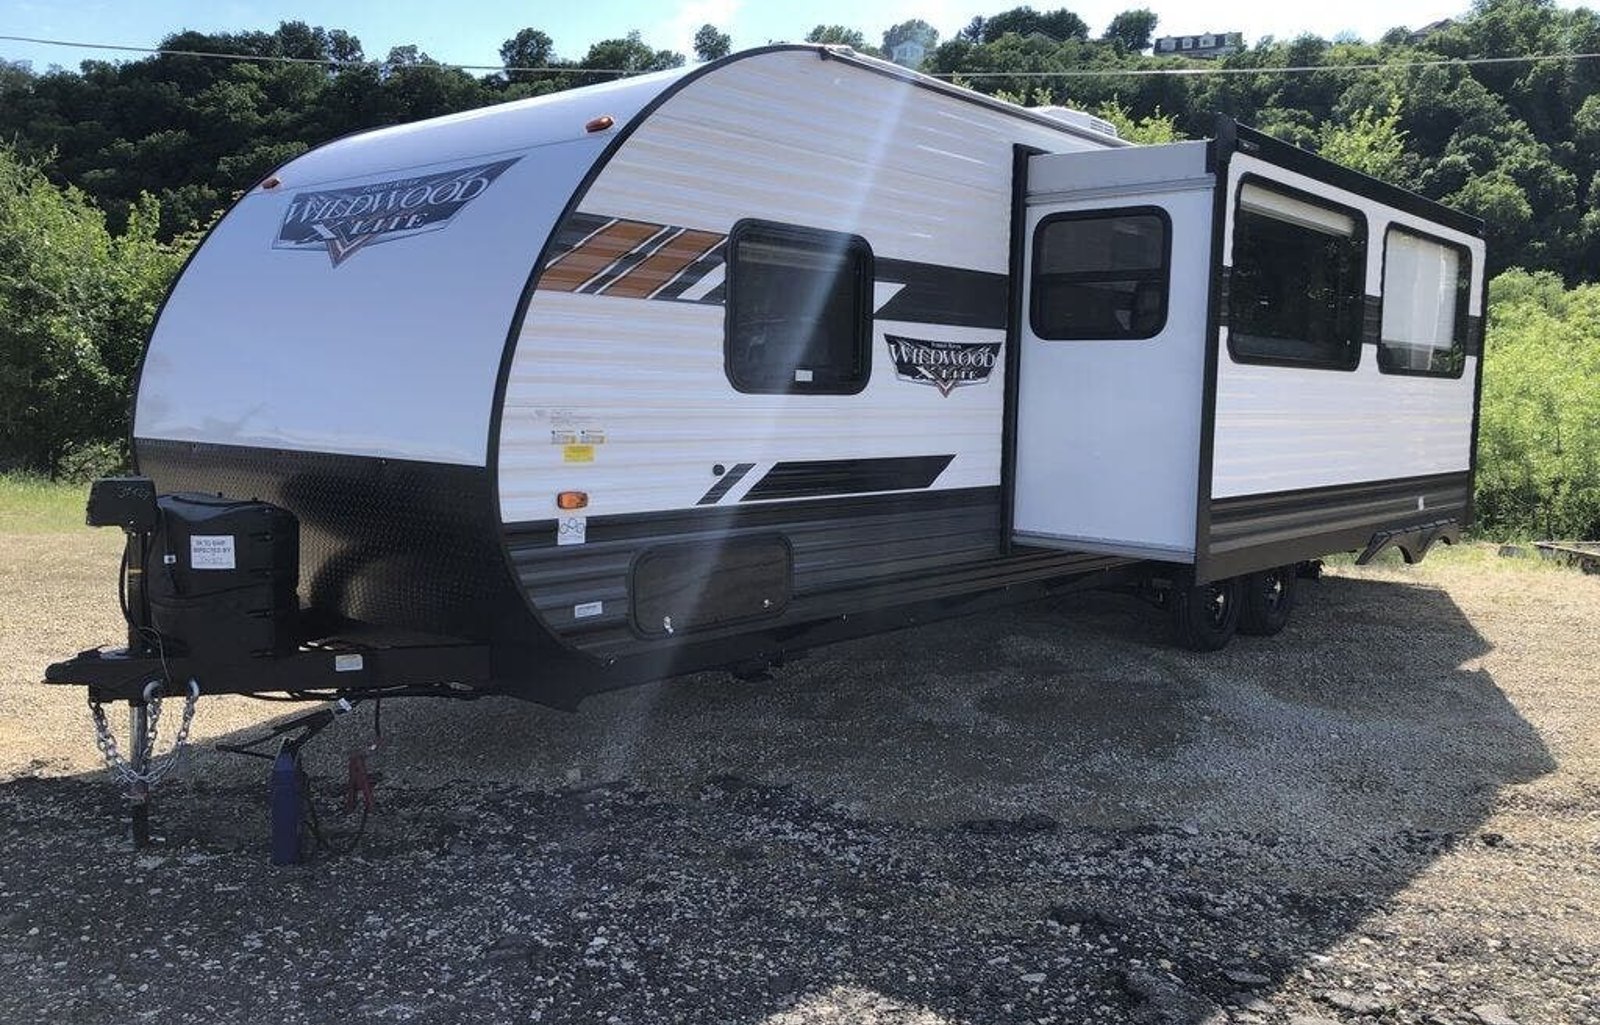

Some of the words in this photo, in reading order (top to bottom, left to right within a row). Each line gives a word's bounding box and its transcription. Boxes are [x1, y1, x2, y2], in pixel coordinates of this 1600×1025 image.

[285, 176, 490, 225] WILDWOOD
[350, 211, 428, 235] LITE
[890, 344, 996, 368] WILDWOOD
[941, 368, 978, 380] LITE
